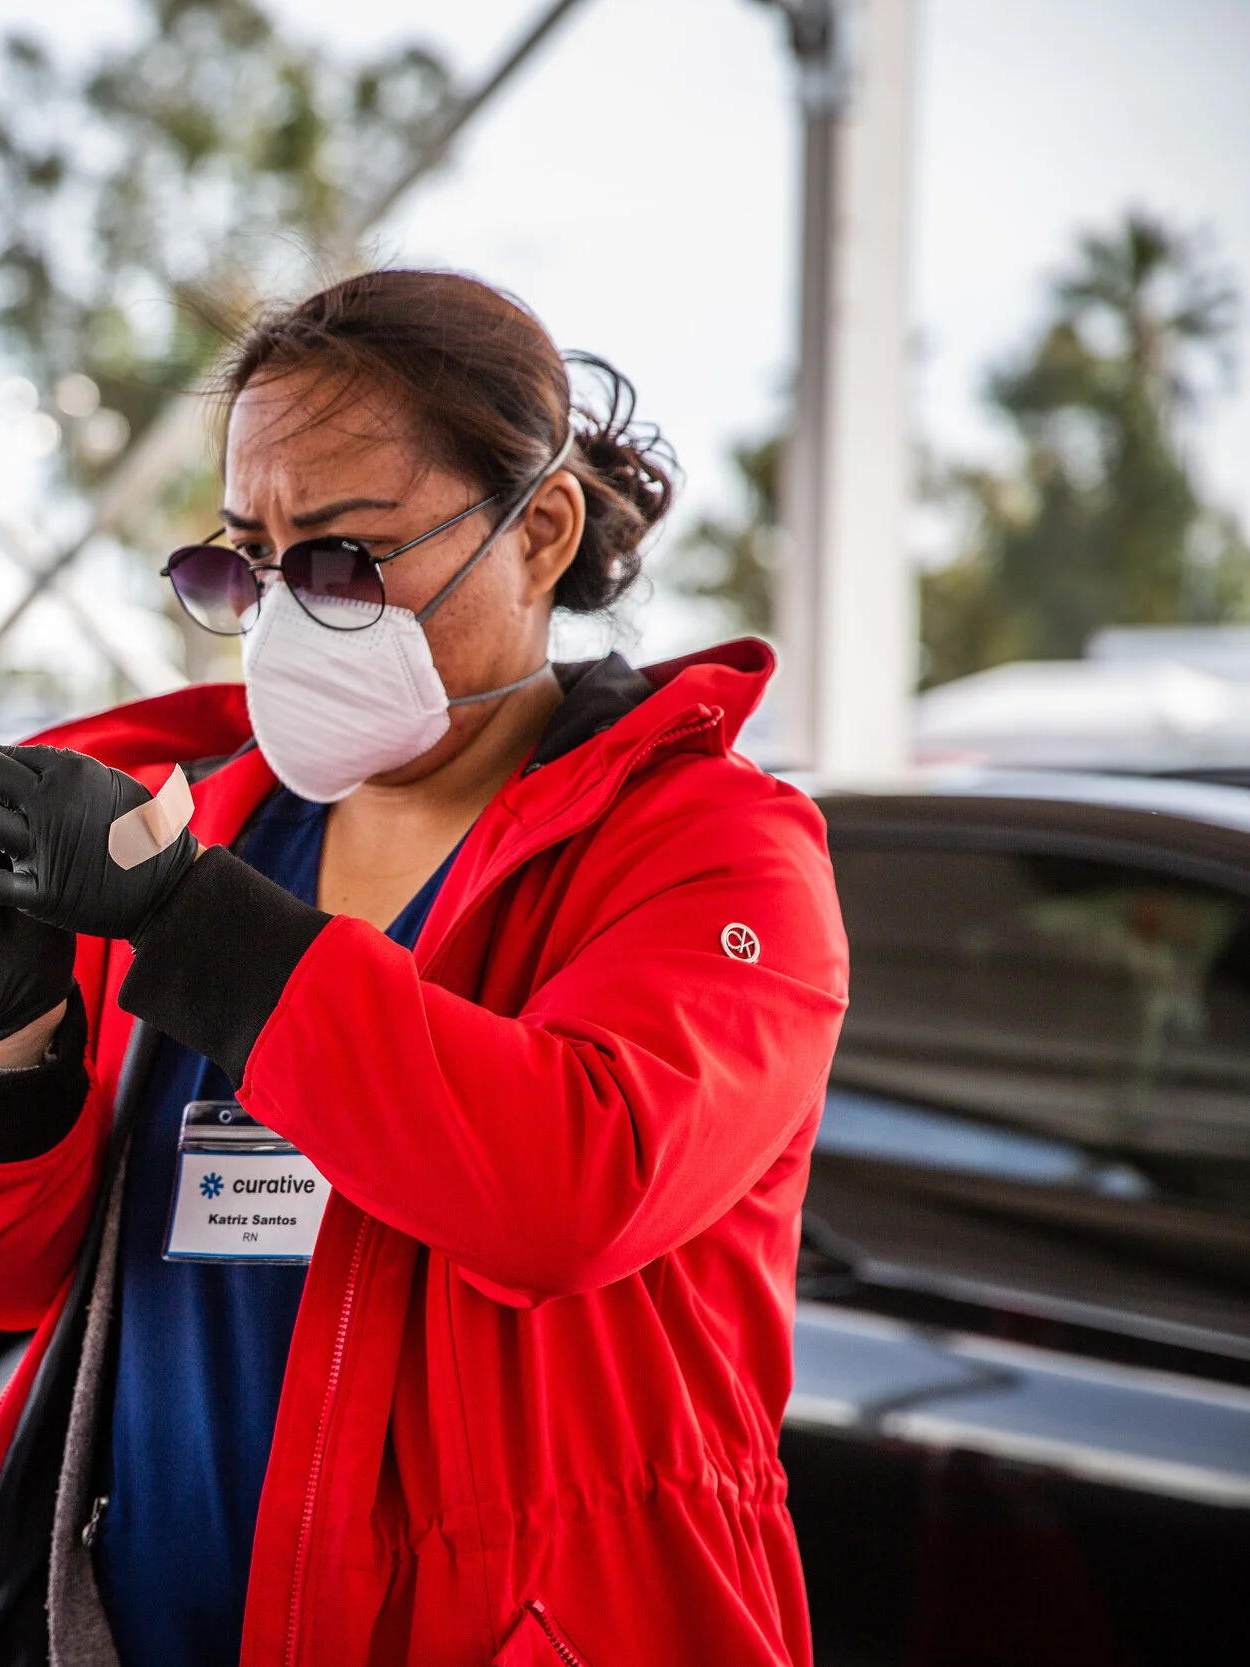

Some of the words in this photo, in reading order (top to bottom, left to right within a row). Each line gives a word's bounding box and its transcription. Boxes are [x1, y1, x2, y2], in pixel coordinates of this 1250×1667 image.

[232, 1174, 316, 1194] curative
[208, 1213, 248, 1225] Katriz
[252, 1214, 297, 1226] Santos
[242, 1232, 258, 1242] RN
